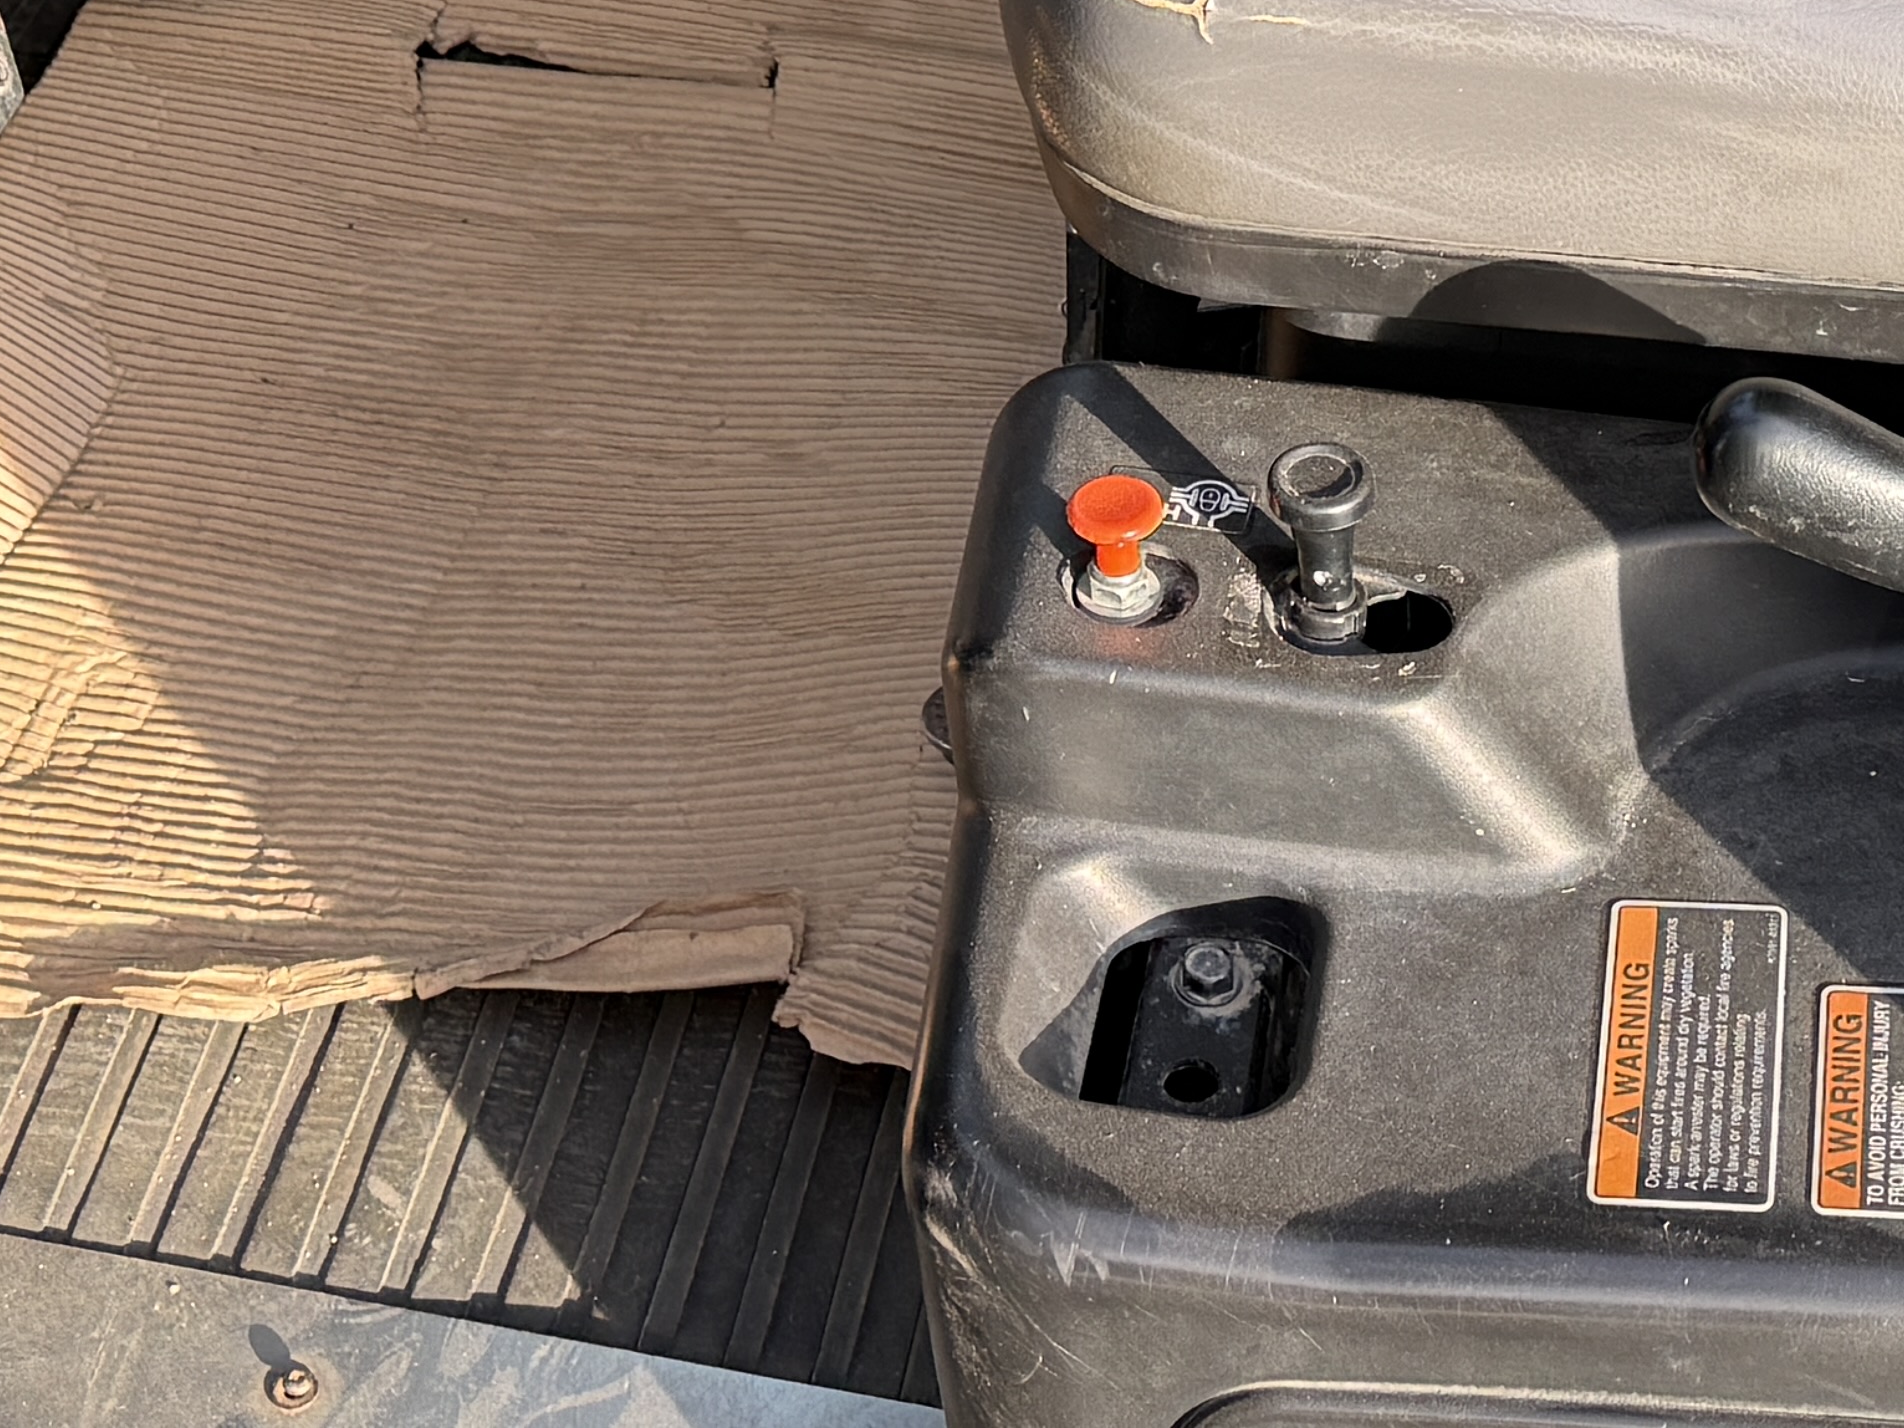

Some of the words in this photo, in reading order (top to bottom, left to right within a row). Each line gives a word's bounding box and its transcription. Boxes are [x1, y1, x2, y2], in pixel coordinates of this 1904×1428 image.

[1666, 918, 1679, 954] sparks
[1662, 958, 1675, 993] create
[1718, 973, 1730, 990] fire
[1660, 997, 1676, 1020] may
[1696, 994, 1711, 1044] required.
[1716, 994, 1730, 1021] local
[1614, 963, 1650, 1095] WARNING
[1676, 1015, 1692, 1034] dry
[1733, 1014, 1750, 1056] relating
[1873, 1001, 1890, 1051] INJURY
[1655, 1024, 1672, 1085] equipment
[1675, 1037, 1688, 1078] around
[1694, 1047, 1707, 1062] be
[1714, 1025, 1728, 1067] contact
[1749, 1009, 1768, 1089] requirements.
[1695, 1066, 1709, 1091] may
[1711, 1071, 1724, 1110] should
[1730, 1060, 1746, 1126] regulations
[1828, 1014, 1862, 1153] WARNING
[1870, 1055, 1888, 1131] PERSONAL
[1652, 1088, 1666, 1110] this
[1672, 1081, 1685, 1107] fires
[1650, 1114, 1664, 1125] of
[1669, 1110, 1684, 1136] start
[1691, 1095, 1705, 1141] arrester
[1747, 1092, 1765, 1155] prevention
[1708, 1114, 1724, 1164] operator
[1729, 1128, 1741, 1142] or
[1645, 1128, 1665, 1188] Operation
[1671, 1141, 1683, 1163] can
[1688, 1144, 1702, 1178] spark
[1725, 1145, 1740, 1172] laws
[1868, 1137, 1886, 1181] AVOID
[1667, 1166, 1681, 1189] that
[1705, 1167, 1718, 1190] The
[1745, 1159, 1759, 1178] fire
[1685, 1181, 1698, 1190] A
[1725, 1176, 1738, 1192] for
[1745, 1181, 1758, 1192] to
[1867, 1186, 1884, 1205] TO
